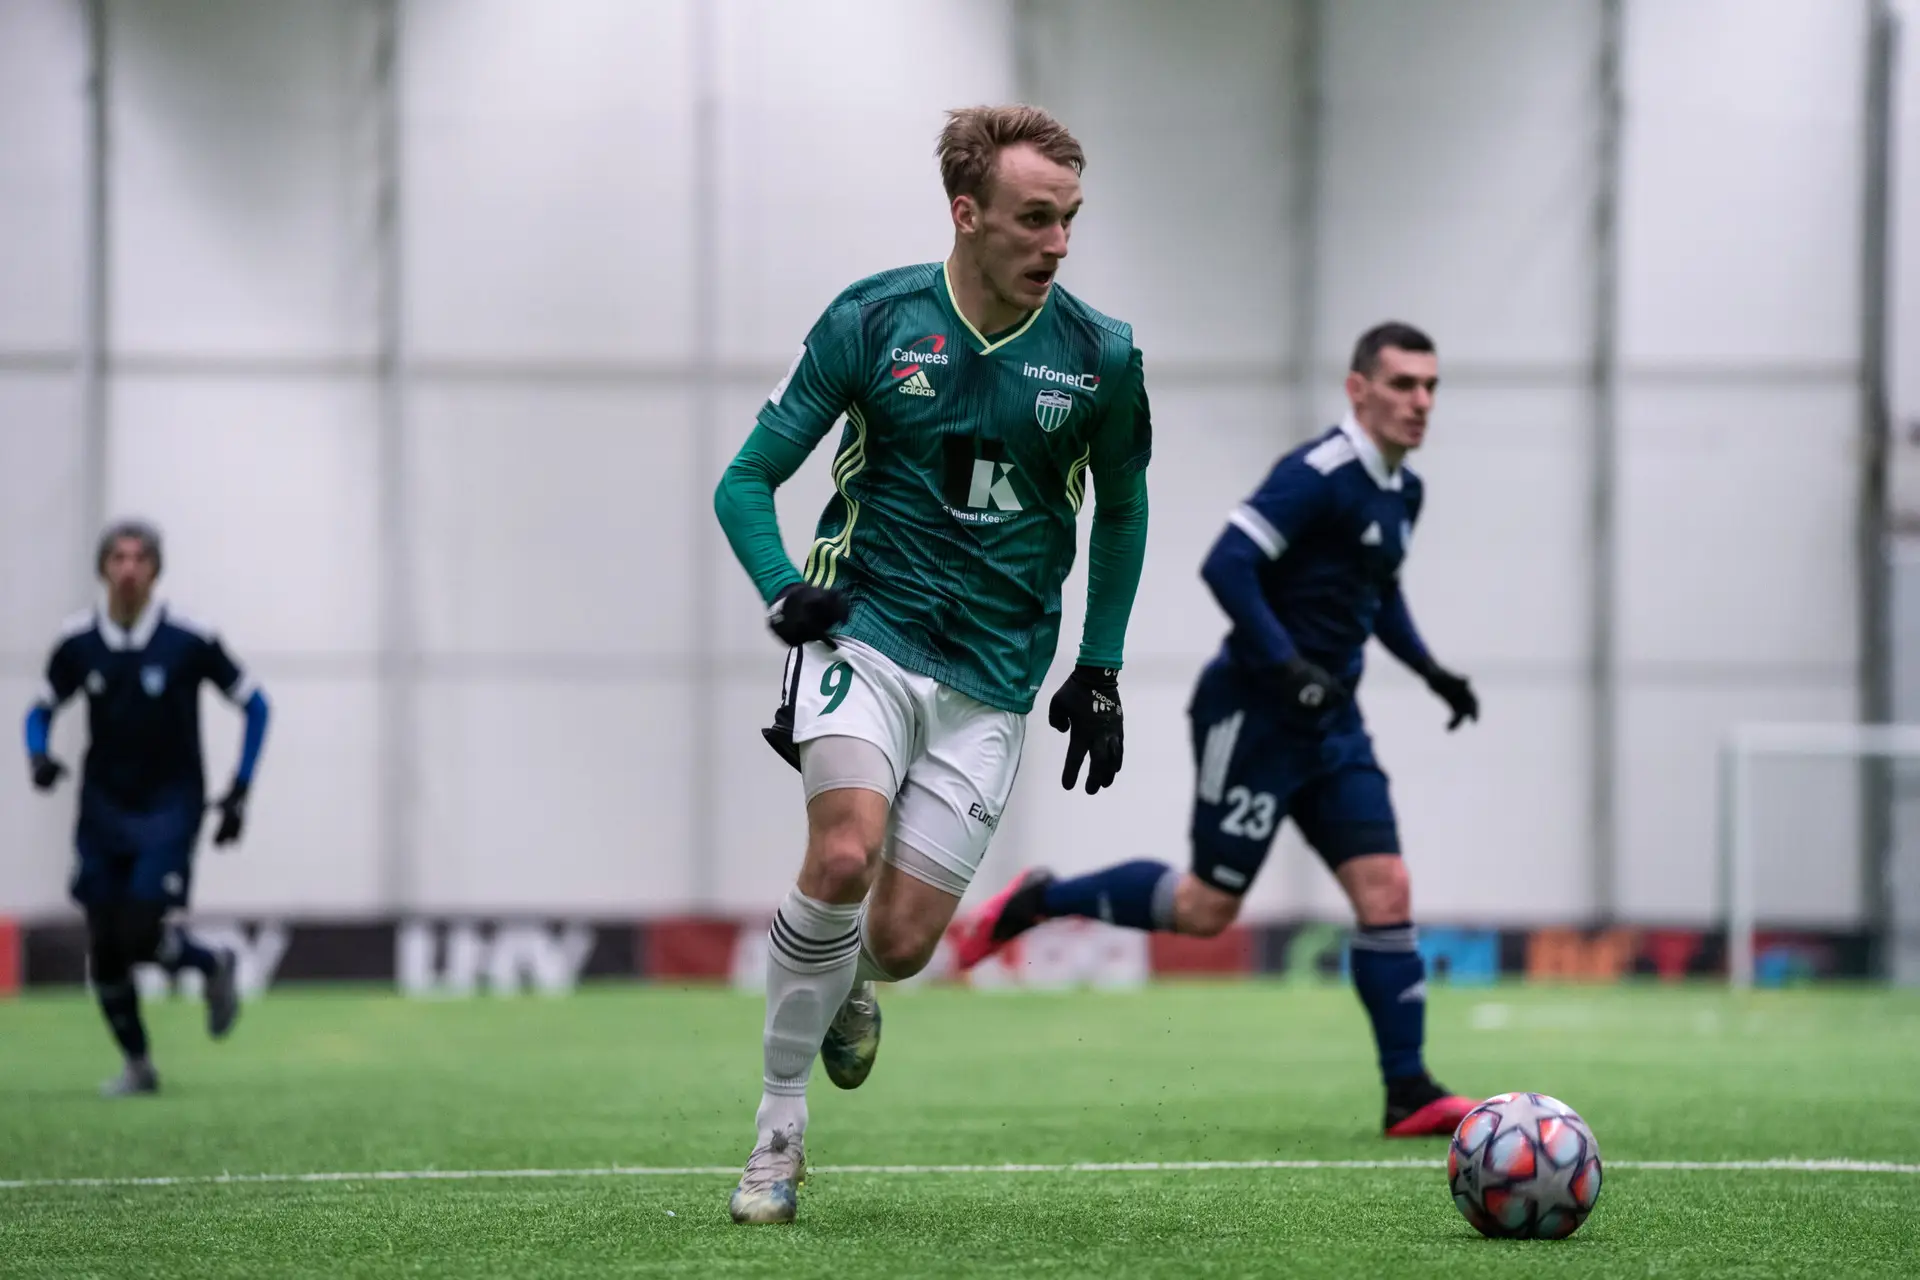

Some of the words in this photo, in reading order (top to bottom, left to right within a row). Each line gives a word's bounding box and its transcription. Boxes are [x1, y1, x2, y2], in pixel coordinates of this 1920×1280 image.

[891, 347, 948, 365] Catwees
[1023, 362, 1081, 387] infonet
[898, 385, 936, 397] adidas
[967, 459, 1023, 510] K
[980, 513, 1018, 523] Keev
[817, 660, 854, 717] 9
[968, 802, 995, 831] Euro
[1219, 785, 1277, 841] 23
